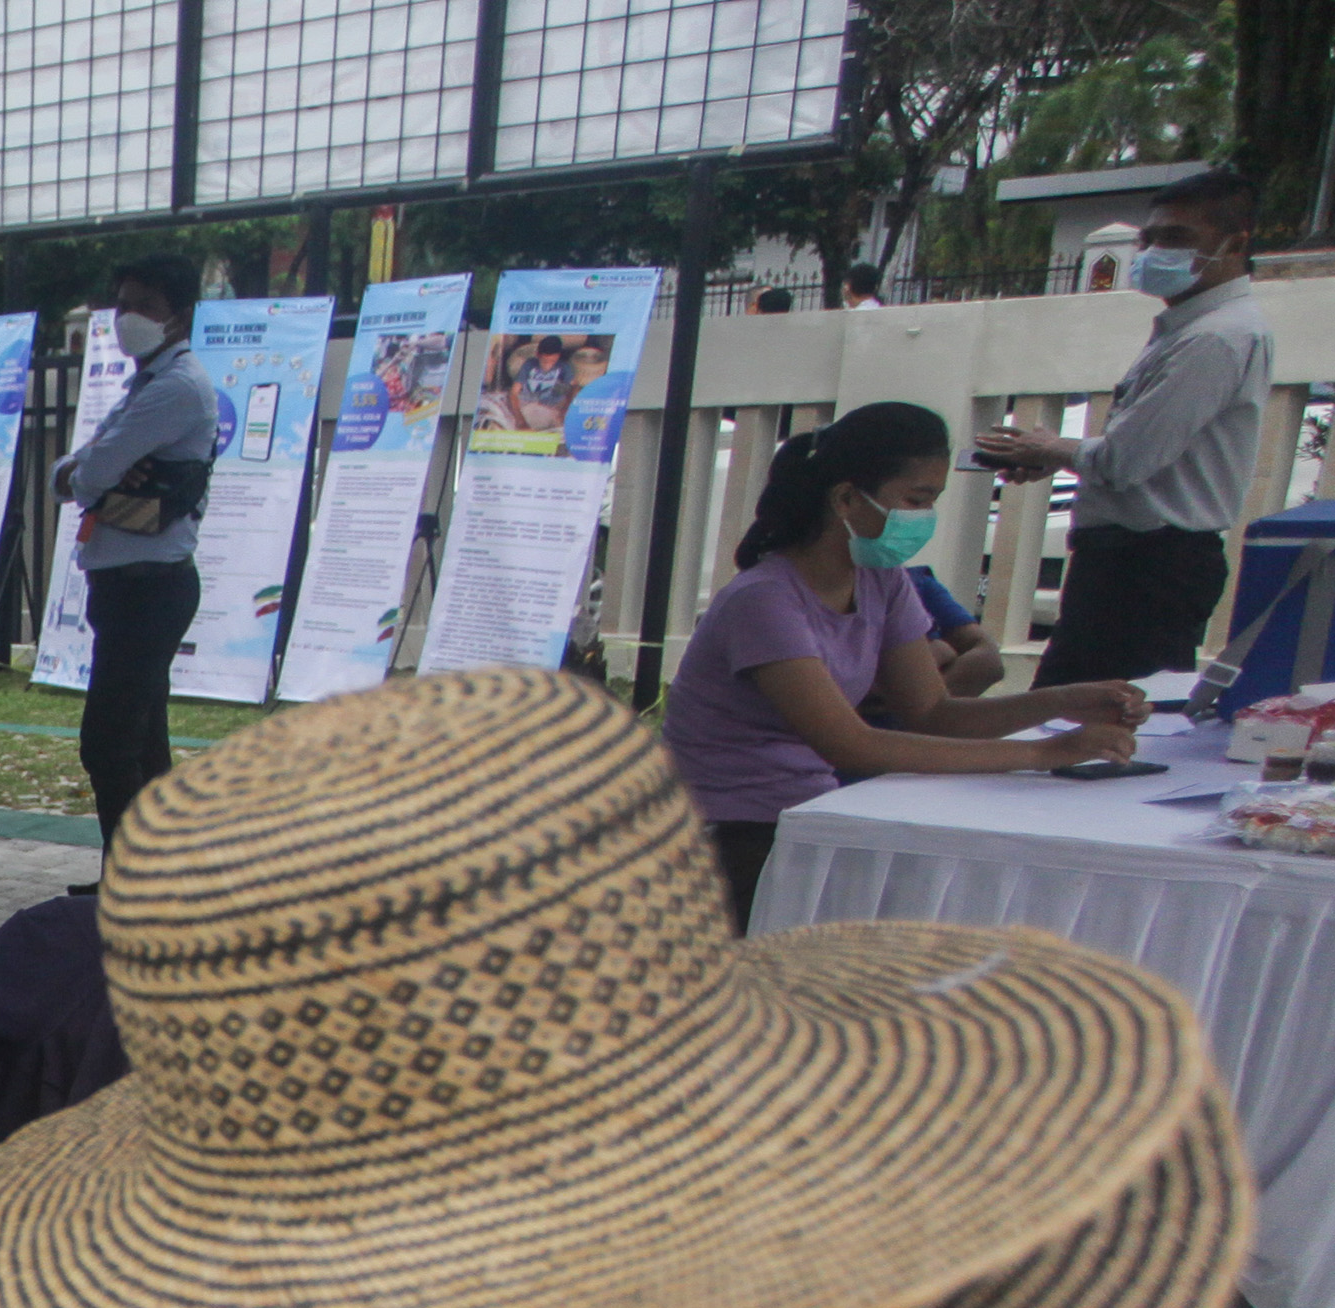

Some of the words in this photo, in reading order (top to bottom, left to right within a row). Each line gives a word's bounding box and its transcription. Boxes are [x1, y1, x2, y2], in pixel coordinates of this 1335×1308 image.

[508, 301, 540, 313] KREDIT
[542, 301, 571, 312] USAHA
[573, 300, 608, 312] RAKYAT
[536, 314, 560, 324] BANK
[562, 313, 602, 324] KALTENG
